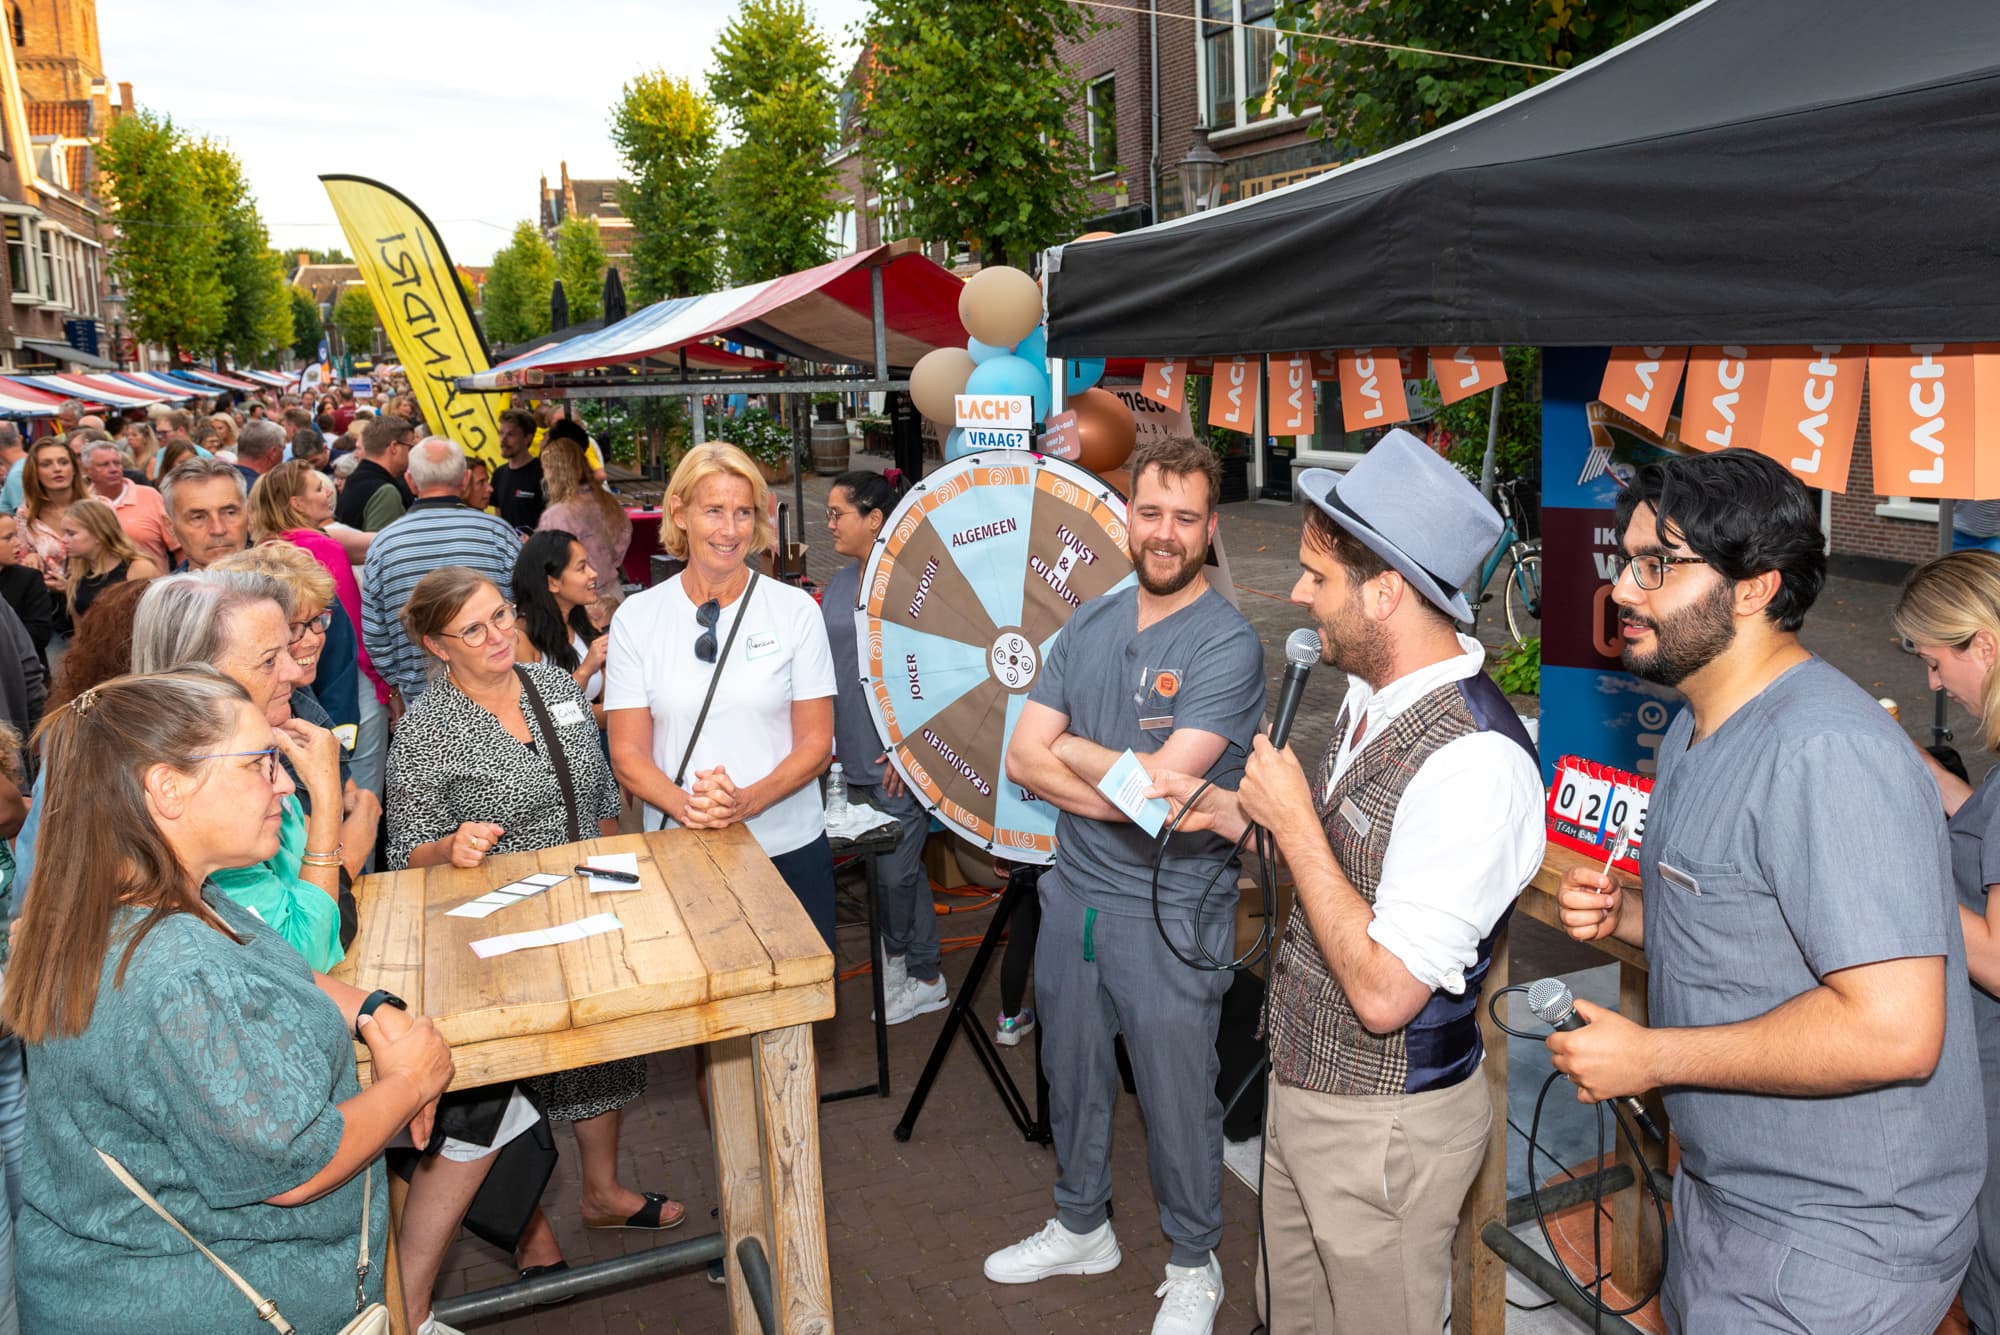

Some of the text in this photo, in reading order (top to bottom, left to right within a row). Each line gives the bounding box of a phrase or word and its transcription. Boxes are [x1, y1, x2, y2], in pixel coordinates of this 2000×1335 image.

[1909, 343, 1945, 484] LACH
[969, 431, 1023, 448] VRAAG?
[952, 517, 1017, 547] ALGEMEEN
[1056, 523, 1099, 566] KUNST
[1029, 555, 1081, 608] CULTUUR
[1058, 556, 1069, 572] &
[908, 555, 940, 620] HISTORIE
[906, 653, 924, 700] JOKER
[922, 728, 992, 797] GEZONDHEID
[1556, 821, 1577, 837] TEAM
